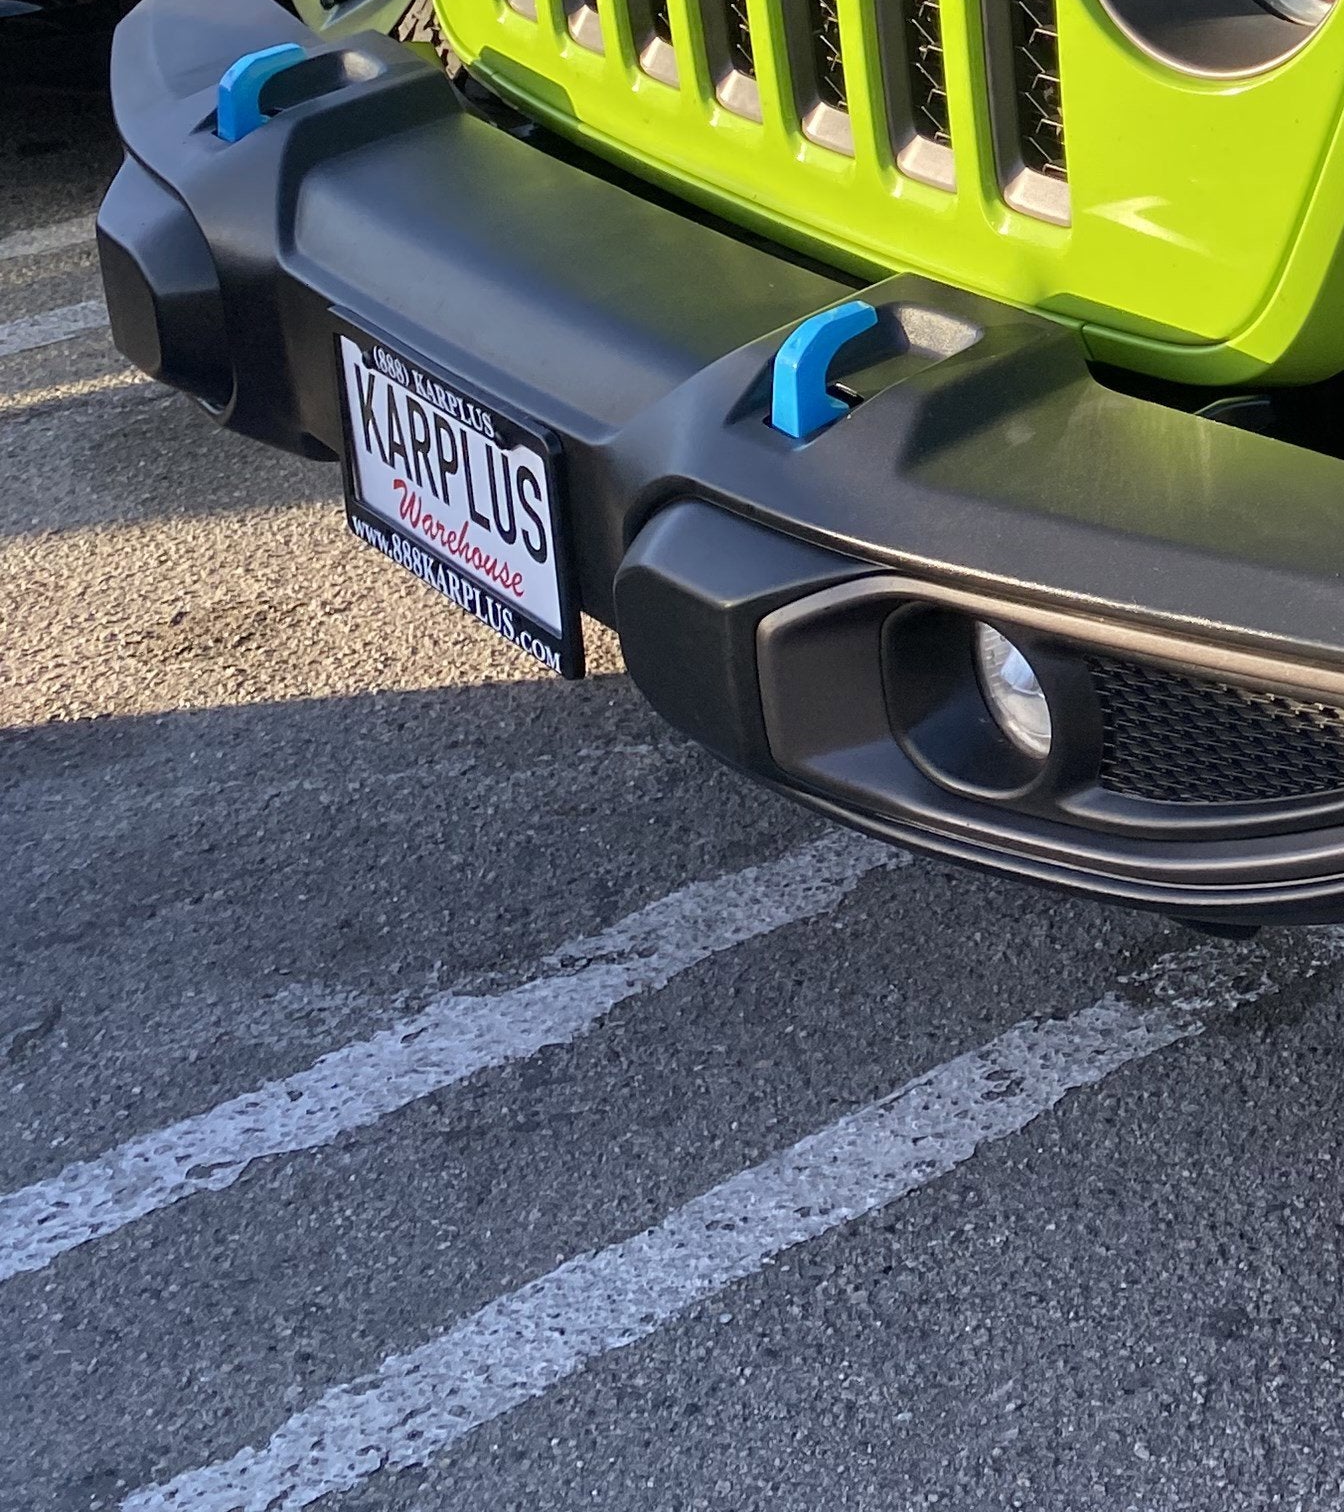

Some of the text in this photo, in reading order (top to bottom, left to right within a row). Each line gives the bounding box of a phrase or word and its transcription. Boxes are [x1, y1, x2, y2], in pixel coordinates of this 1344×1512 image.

[373, 345, 496, 438] (888) KARPLUS
[355, 363, 547, 564] KARPLUS
[393, 478, 525, 597] Warehouse
